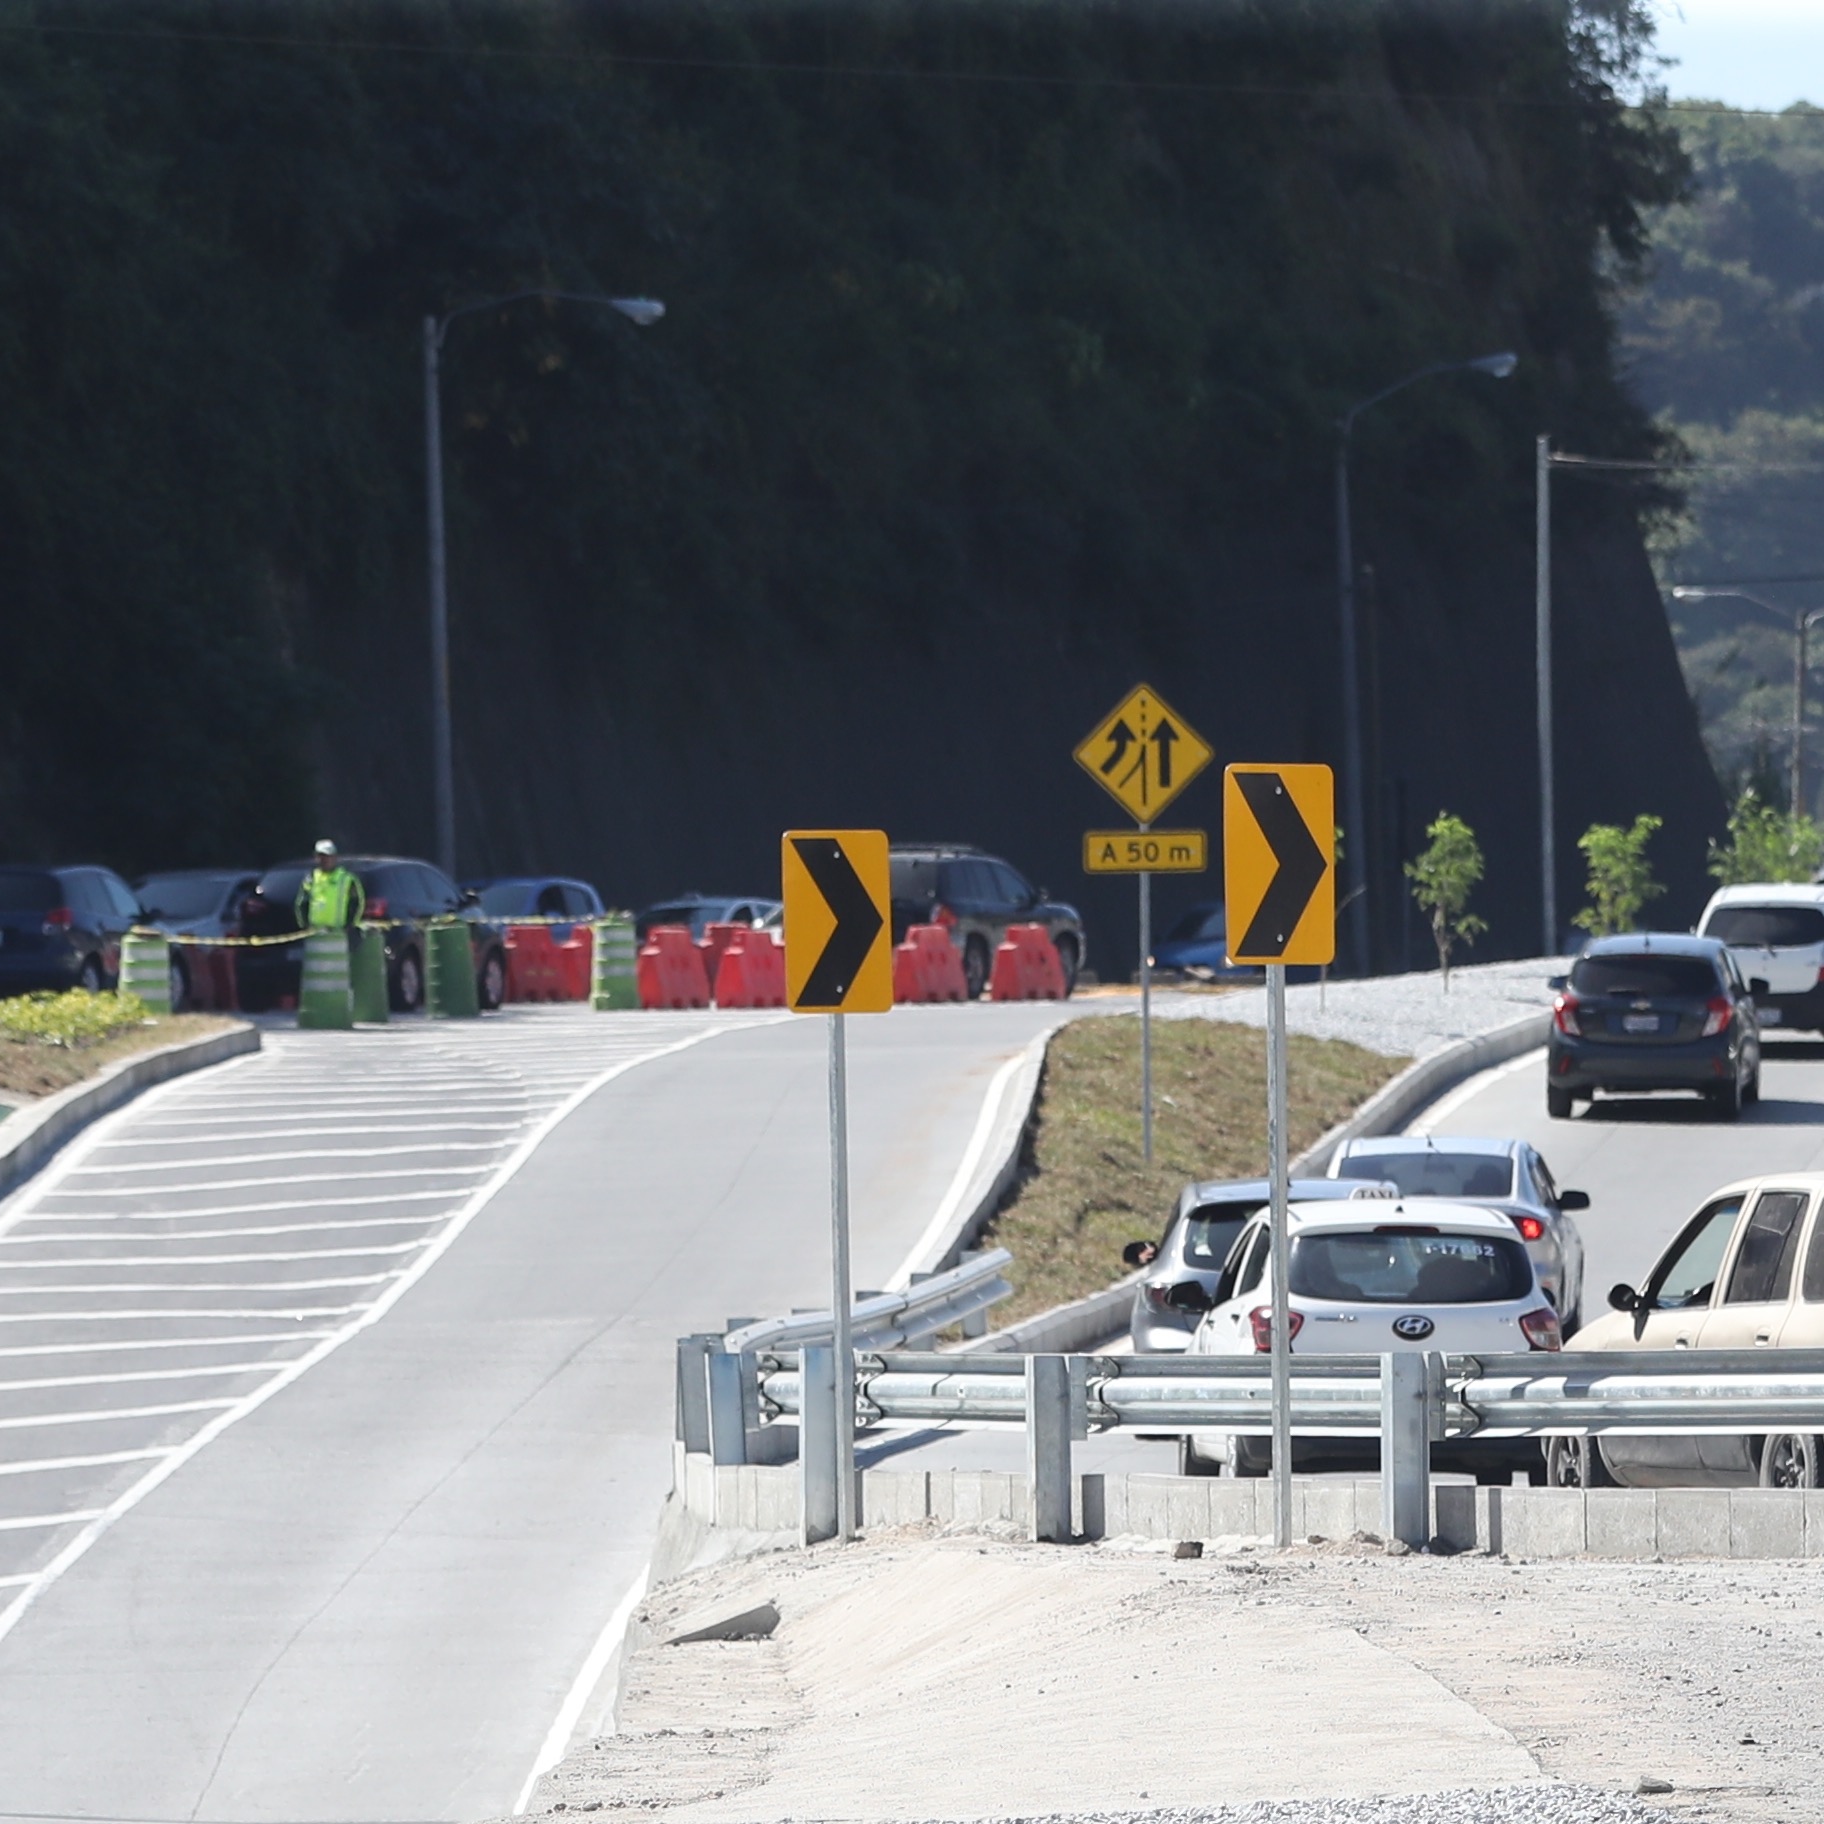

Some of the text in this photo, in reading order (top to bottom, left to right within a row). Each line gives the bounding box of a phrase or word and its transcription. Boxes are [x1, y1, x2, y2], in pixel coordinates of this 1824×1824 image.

[1101, 842, 1190, 863] A 50 m
[1360, 1189, 1393, 1199] TAXI
